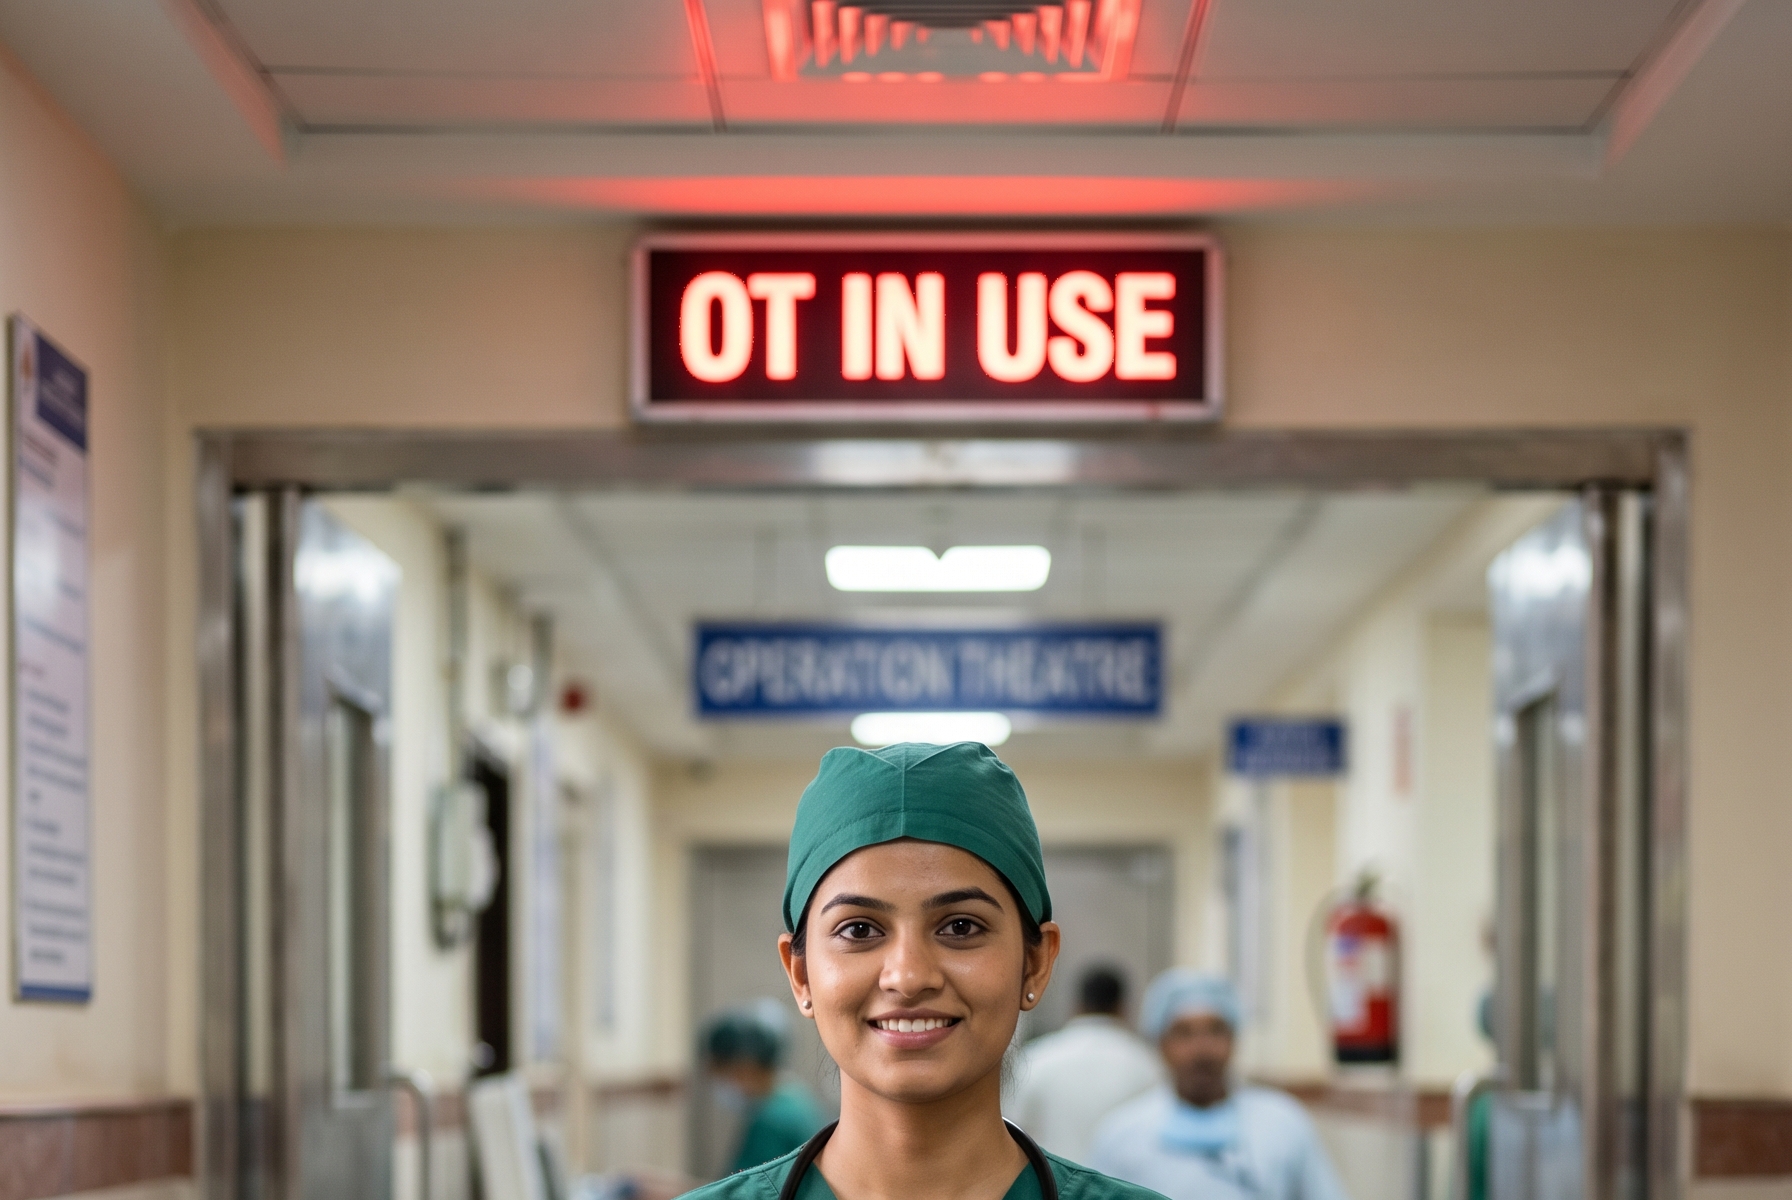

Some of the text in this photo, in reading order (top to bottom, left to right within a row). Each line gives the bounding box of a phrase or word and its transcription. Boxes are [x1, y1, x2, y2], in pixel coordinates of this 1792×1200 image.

[680, 270, 1177, 383] OT IN USE
